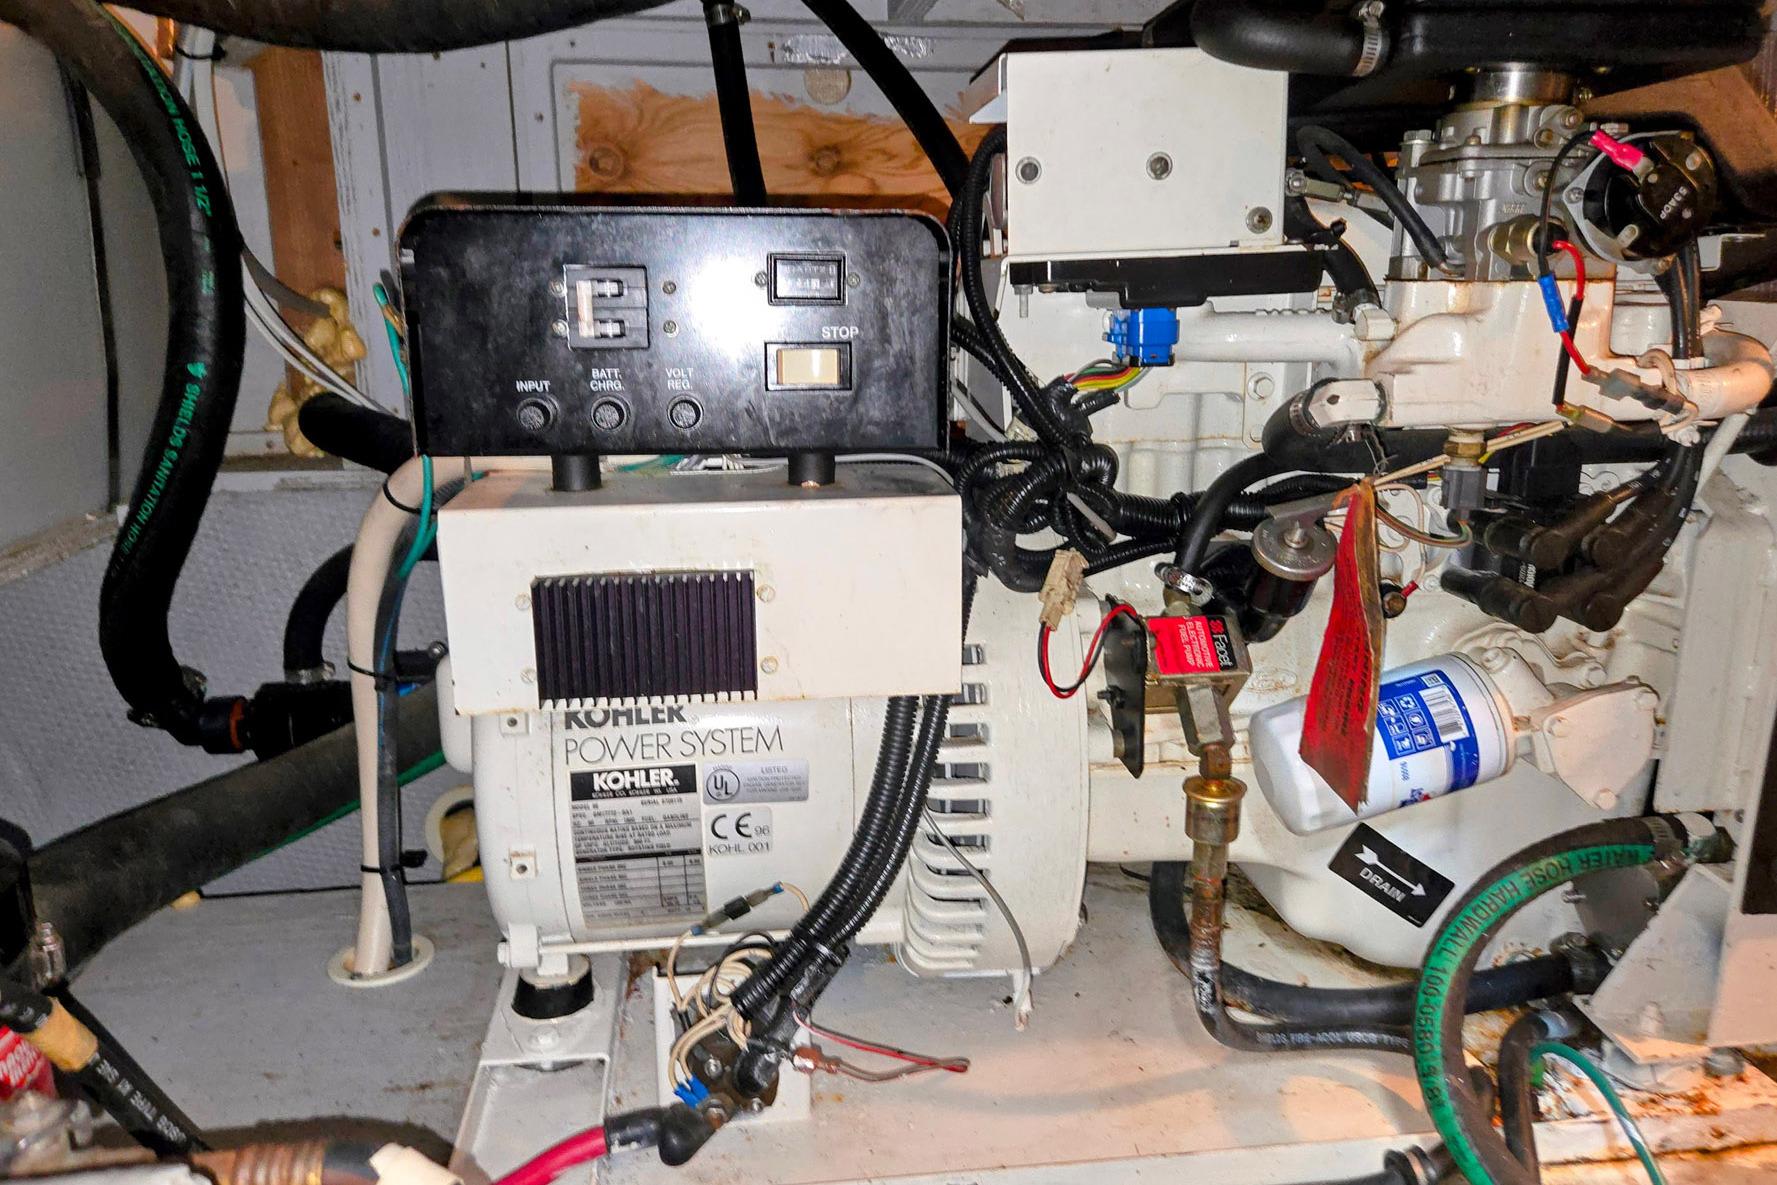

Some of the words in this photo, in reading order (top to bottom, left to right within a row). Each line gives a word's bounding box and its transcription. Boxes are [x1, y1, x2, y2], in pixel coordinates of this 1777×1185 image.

[821, 326, 859, 339] STOP
[516, 380, 550, 393] INPUT
[665, 368, 693, 379] VOLT
[1212, 633, 1234, 668] Facet
[565, 733, 672, 765] POWER
[680, 725, 784, 757] SYSTEM
[714, 774, 733, 796] UL
[1360, 867, 1407, 902] DRAIN
[1526, 858, 1572, 887] HOSE
[1440, 878, 1521, 958] HARDWALL
